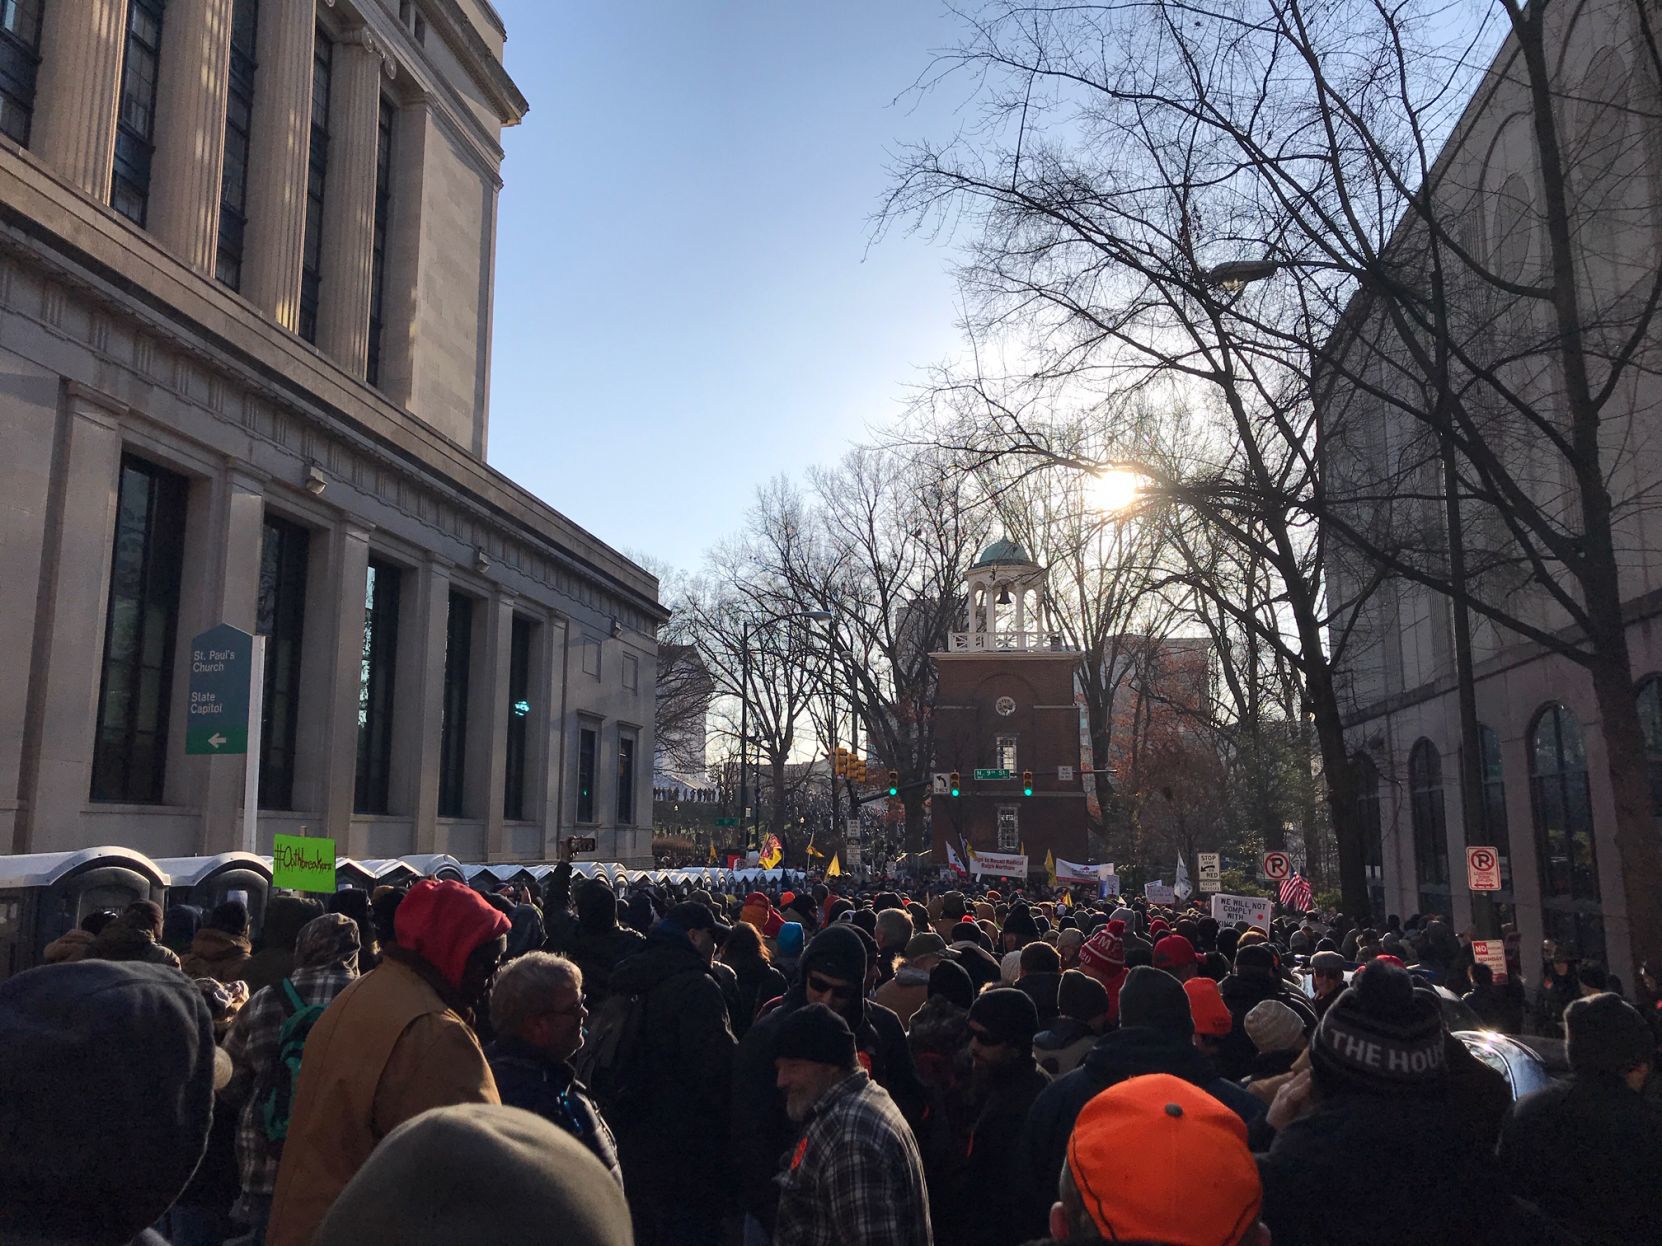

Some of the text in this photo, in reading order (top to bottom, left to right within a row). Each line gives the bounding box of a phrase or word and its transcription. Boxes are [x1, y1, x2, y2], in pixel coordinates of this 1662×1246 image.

[194, 649, 235, 661] St. Paul's
[192, 661, 225, 673] Church
[191, 691, 216, 702] State
[190, 703, 223, 715] Capitol
[1223, 905, 1252, 916] COMPLY
[1233, 899, 1250, 908] WILL
[1252, 903, 1267, 911] NOT
[1227, 913, 1244, 921] WITH
[1475, 945, 1487, 953] NO
[1330, 1028, 1382, 1067] THE
